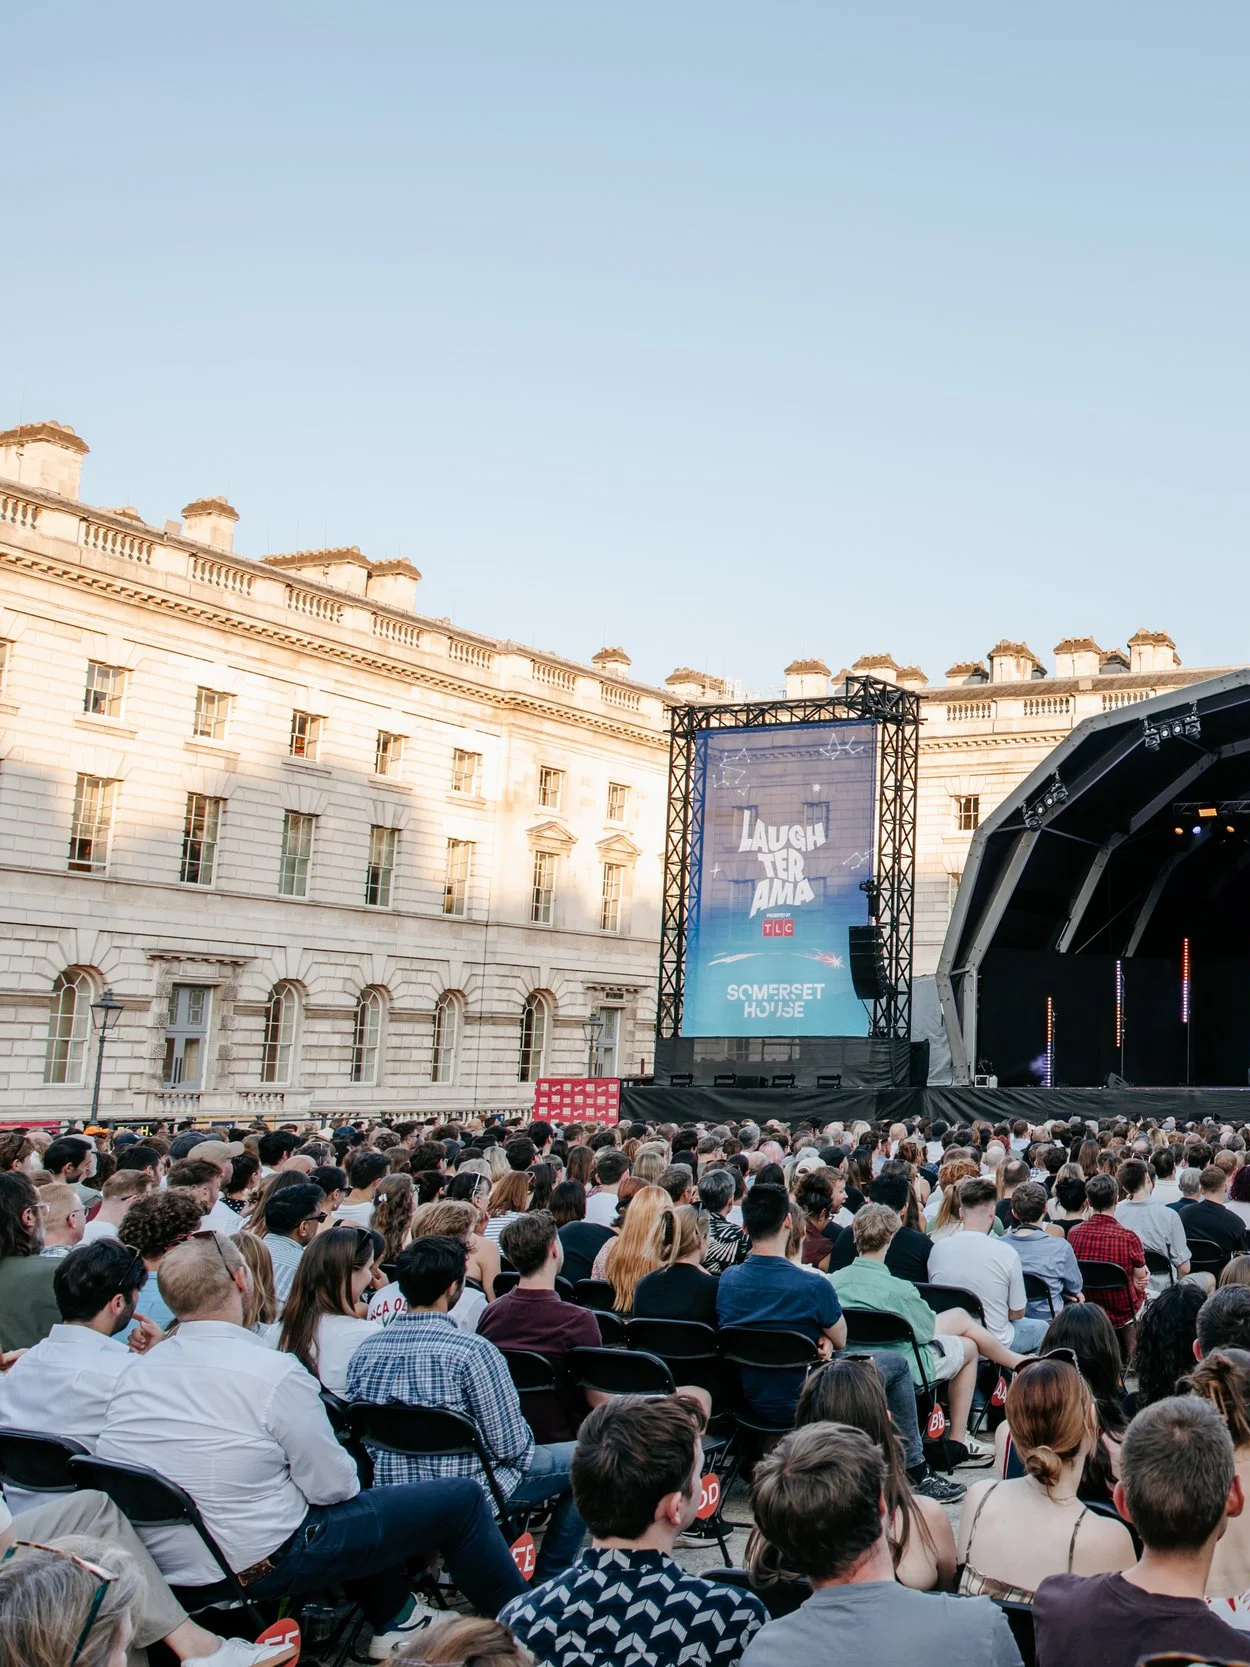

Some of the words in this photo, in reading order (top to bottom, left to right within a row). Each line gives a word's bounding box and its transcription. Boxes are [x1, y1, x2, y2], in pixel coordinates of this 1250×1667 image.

[738, 809, 826, 853] LAUGH
[757, 848, 805, 882] TER
[749, 878, 815, 920] AMA
[764, 923, 793, 934] TLC
[727, 983, 826, 1001] SOMERSET
[743, 1001, 805, 1018] HOUSE
[993, 1382, 1007, 1404] AA
[929, 1411, 945, 1432] BB
